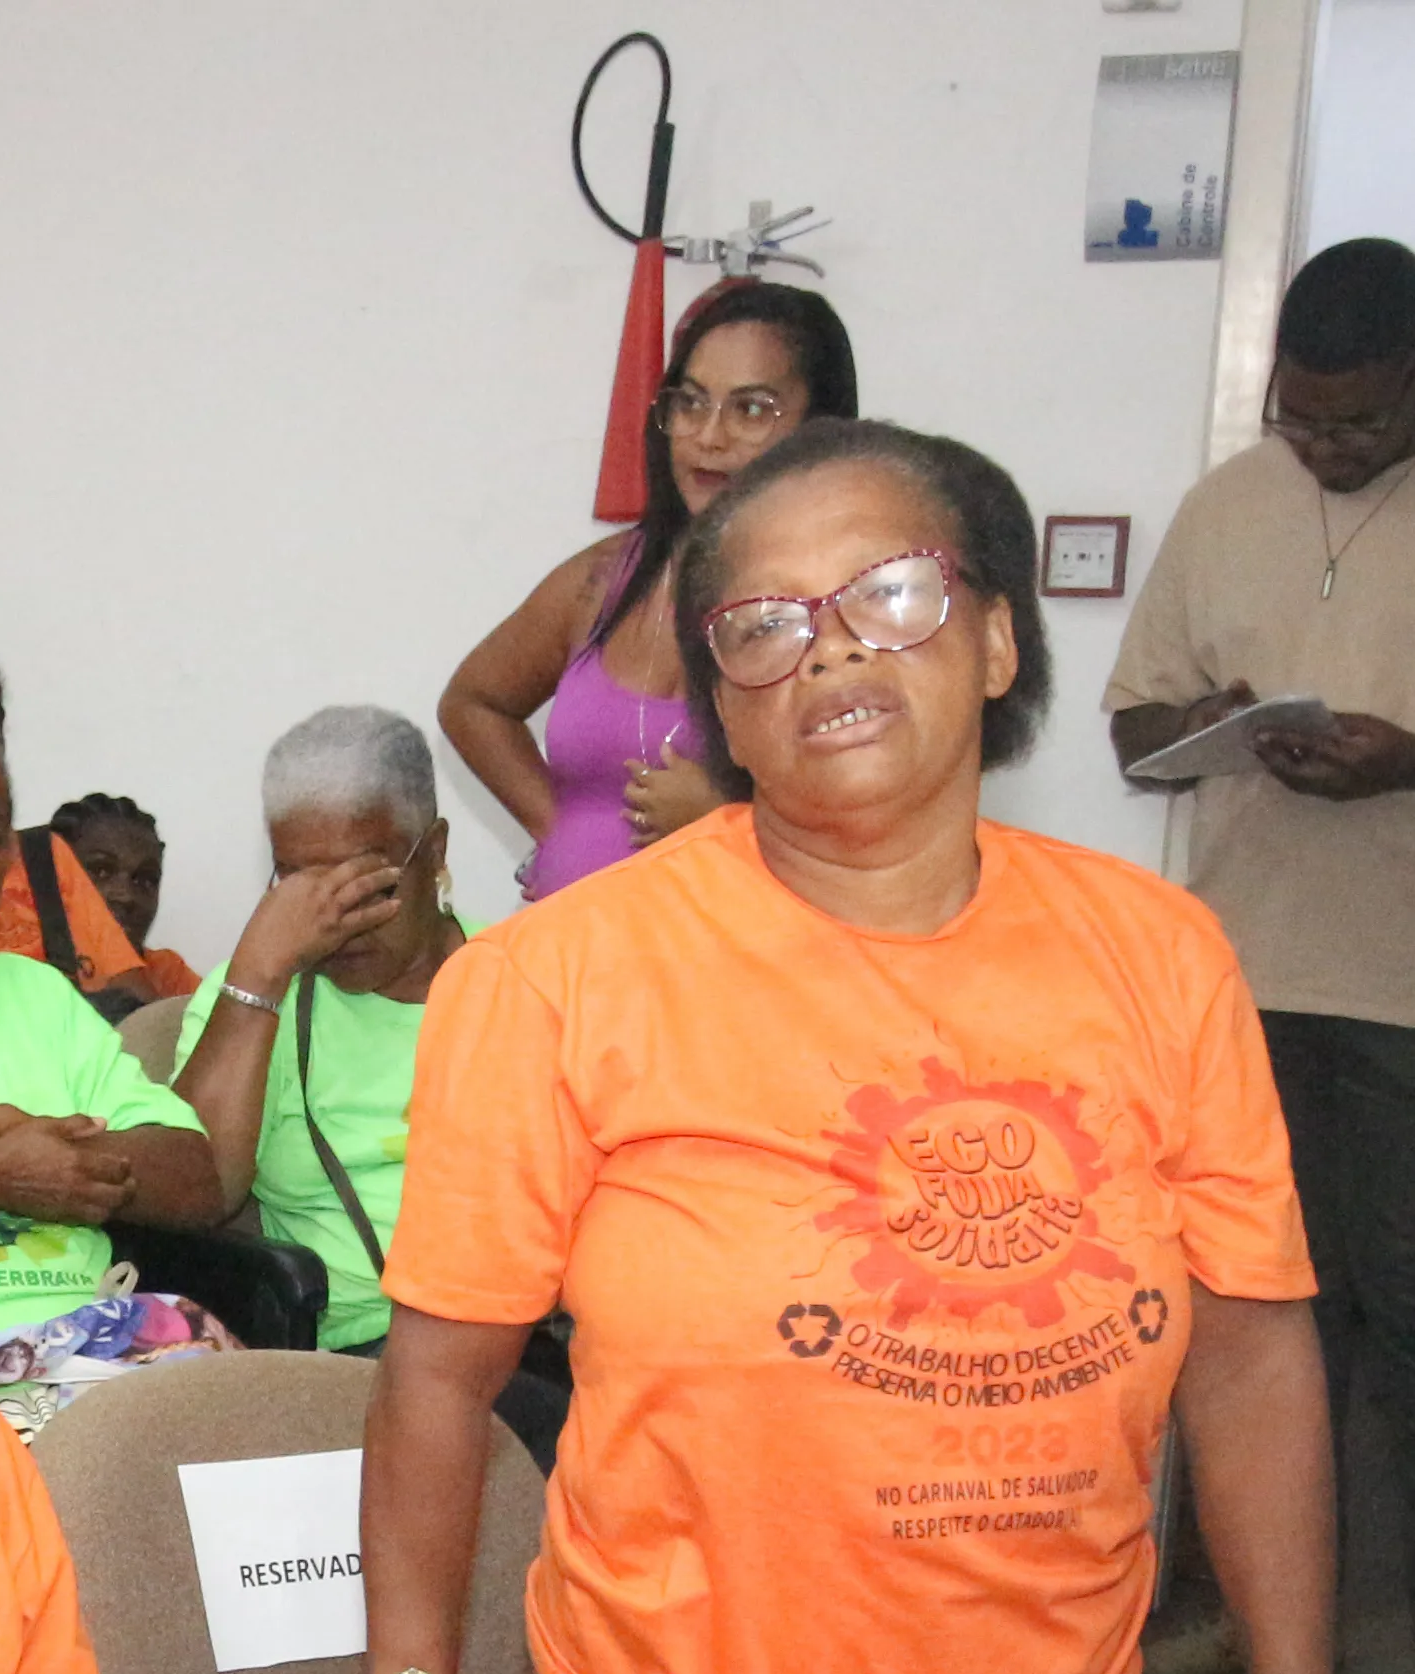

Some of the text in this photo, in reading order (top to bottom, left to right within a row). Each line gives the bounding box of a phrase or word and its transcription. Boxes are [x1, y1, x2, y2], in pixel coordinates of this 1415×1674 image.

[1176, 163, 1197, 248] Cabine de
[1198, 174, 1218, 248] Controle
[887, 1118, 1035, 1174] ECO
[847, 1313, 1126, 1378] O TRABALHO DECENTE
[831, 1341, 1135, 1407] PRESERVA O MEIO AMBIENTE
[931, 1423, 1070, 1467] 2023
[876, 1486, 901, 1506] NO
[908, 1479, 995, 1505] CARNAVAL
[1002, 1477, 1021, 1499] DE
[892, 1515, 973, 1540] RESPEITE
[976, 1514, 991, 1532] O
[239, 1553, 362, 1588] RESERVAD
